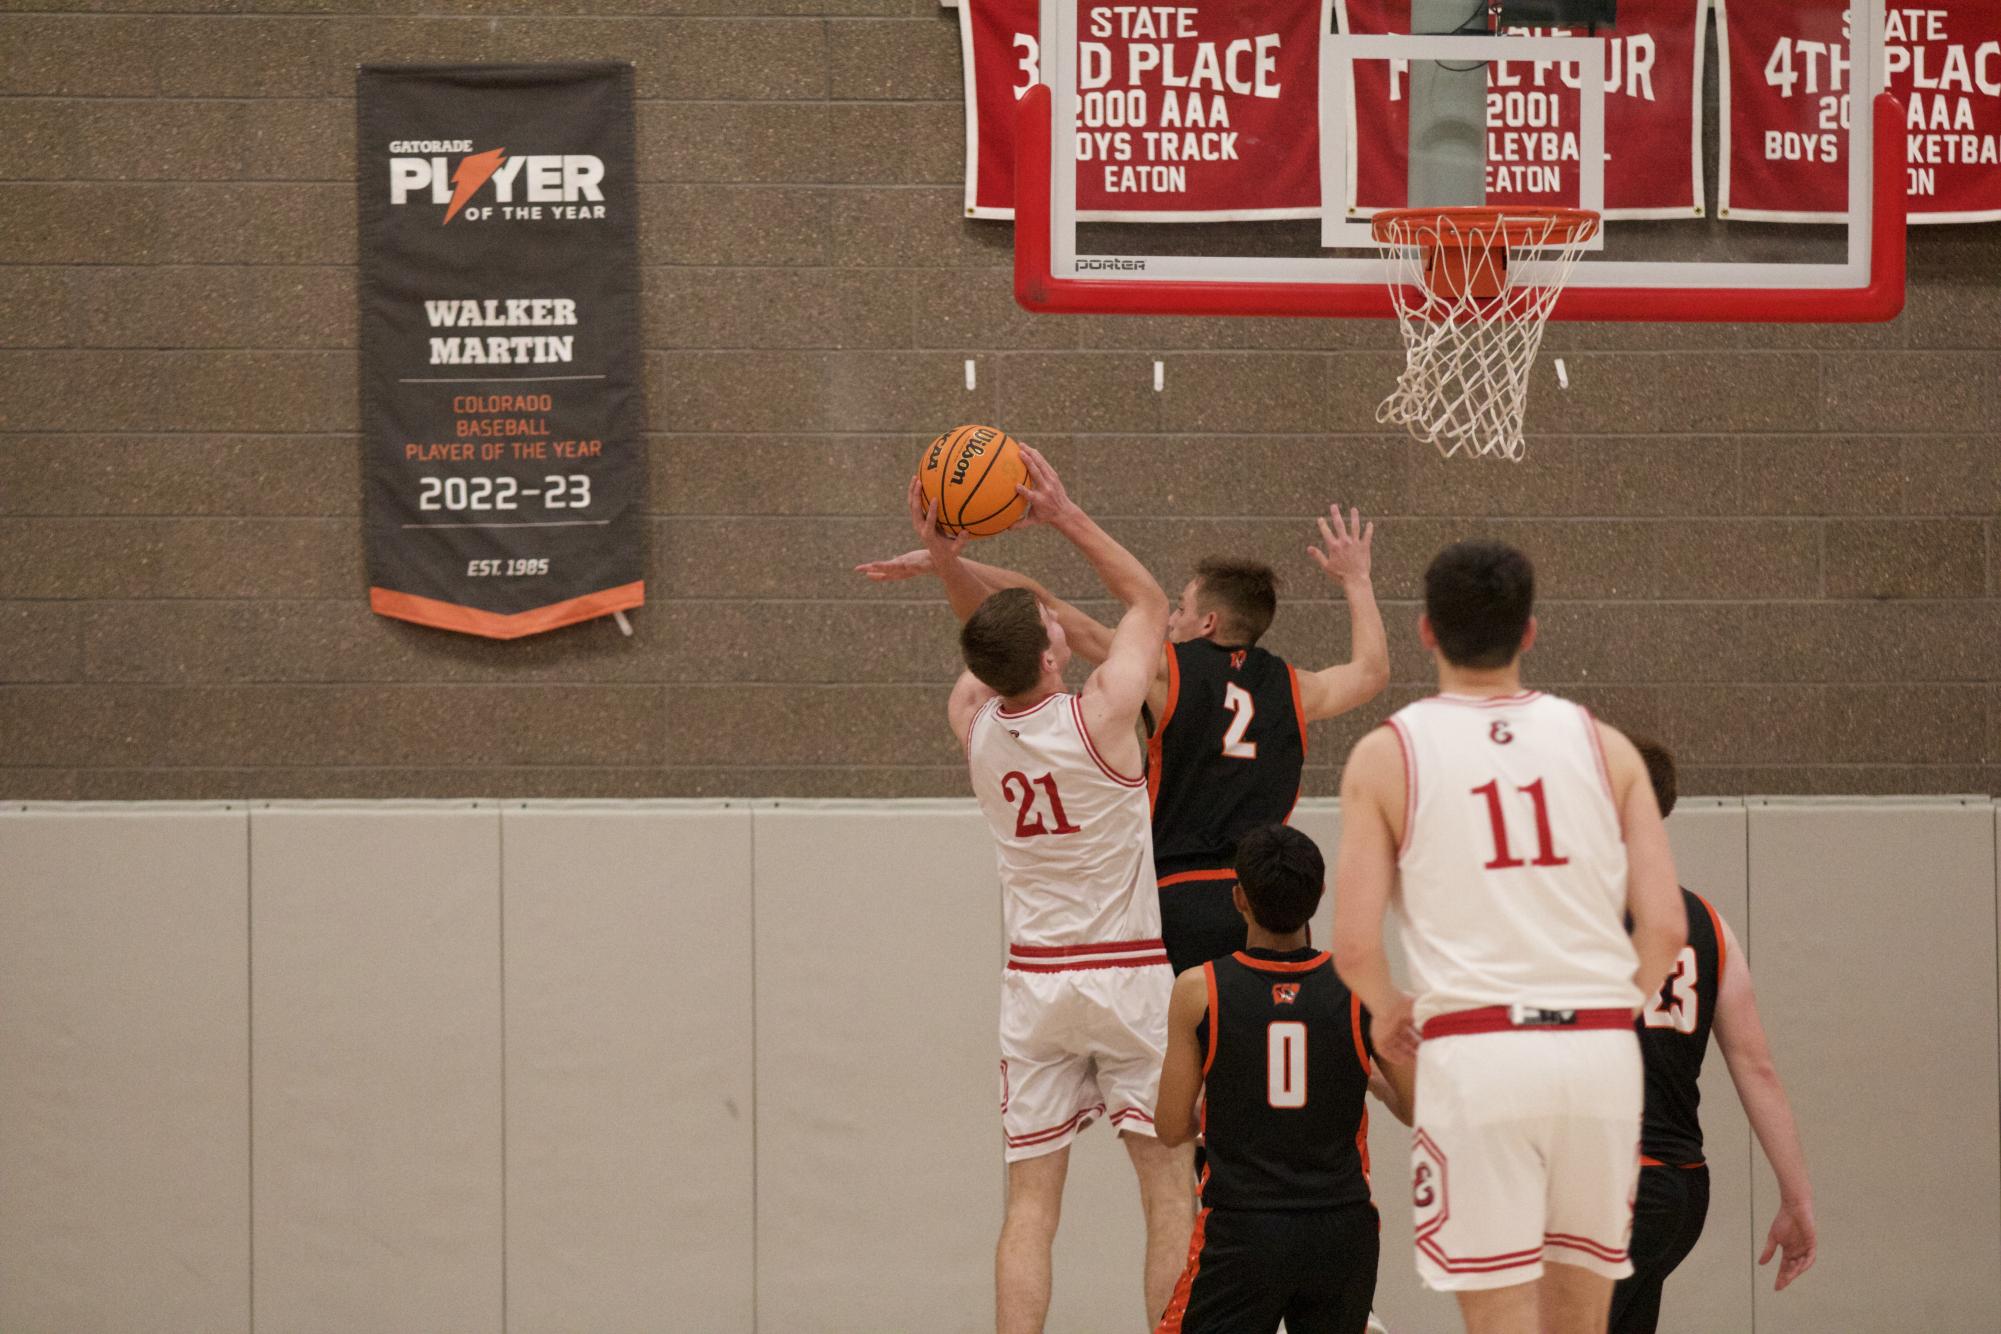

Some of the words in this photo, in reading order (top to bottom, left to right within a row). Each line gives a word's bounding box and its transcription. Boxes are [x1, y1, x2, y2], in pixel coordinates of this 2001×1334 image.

[1091, 7, 1198, 39] STATE
[1842, 9, 1948, 42] ATE
[1013, 33, 1112, 101] 3D
[1128, 33, 1281, 99] PLACE
[1884, 41, 2001, 97] PLAC
[1160, 91, 1230, 128] AAA
[1487, 91, 1559, 127] 2001
[1907, 92, 1975, 130] AAA
[389, 140, 472, 153] GATORADE
[1076, 132, 1132, 161] OYS
[1142, 132, 1239, 161] TRACK
[1765, 130, 1838, 163] BOYS
[1104, 165, 1186, 193] EATON
[465, 207, 493, 221] OF
[503, 206, 542, 220] THE
[551, 205, 606, 219] YEAR
[425, 298, 578, 327] WALKER
[429, 335, 574, 365] MARTIN
[453, 394, 552, 414] COLORADO
[456, 419, 549, 437] BASEBALL
[405, 442, 475, 462] PLAYER
[481, 442, 505, 460] OF
[512, 441, 547, 459] THE
[552, 440, 602, 458] YEAR
[950, 428, 998, 485] Wilson
[419, 474, 591, 510] 2022-23
[467, 560, 502, 577] EST.
[506, 558, 550, 576] 1985
[1221, 681, 1257, 760] 2
[1001, 770, 1081, 838] 21
[1470, 777, 1569, 869] 11
[1267, 1020, 1308, 1110] 0
